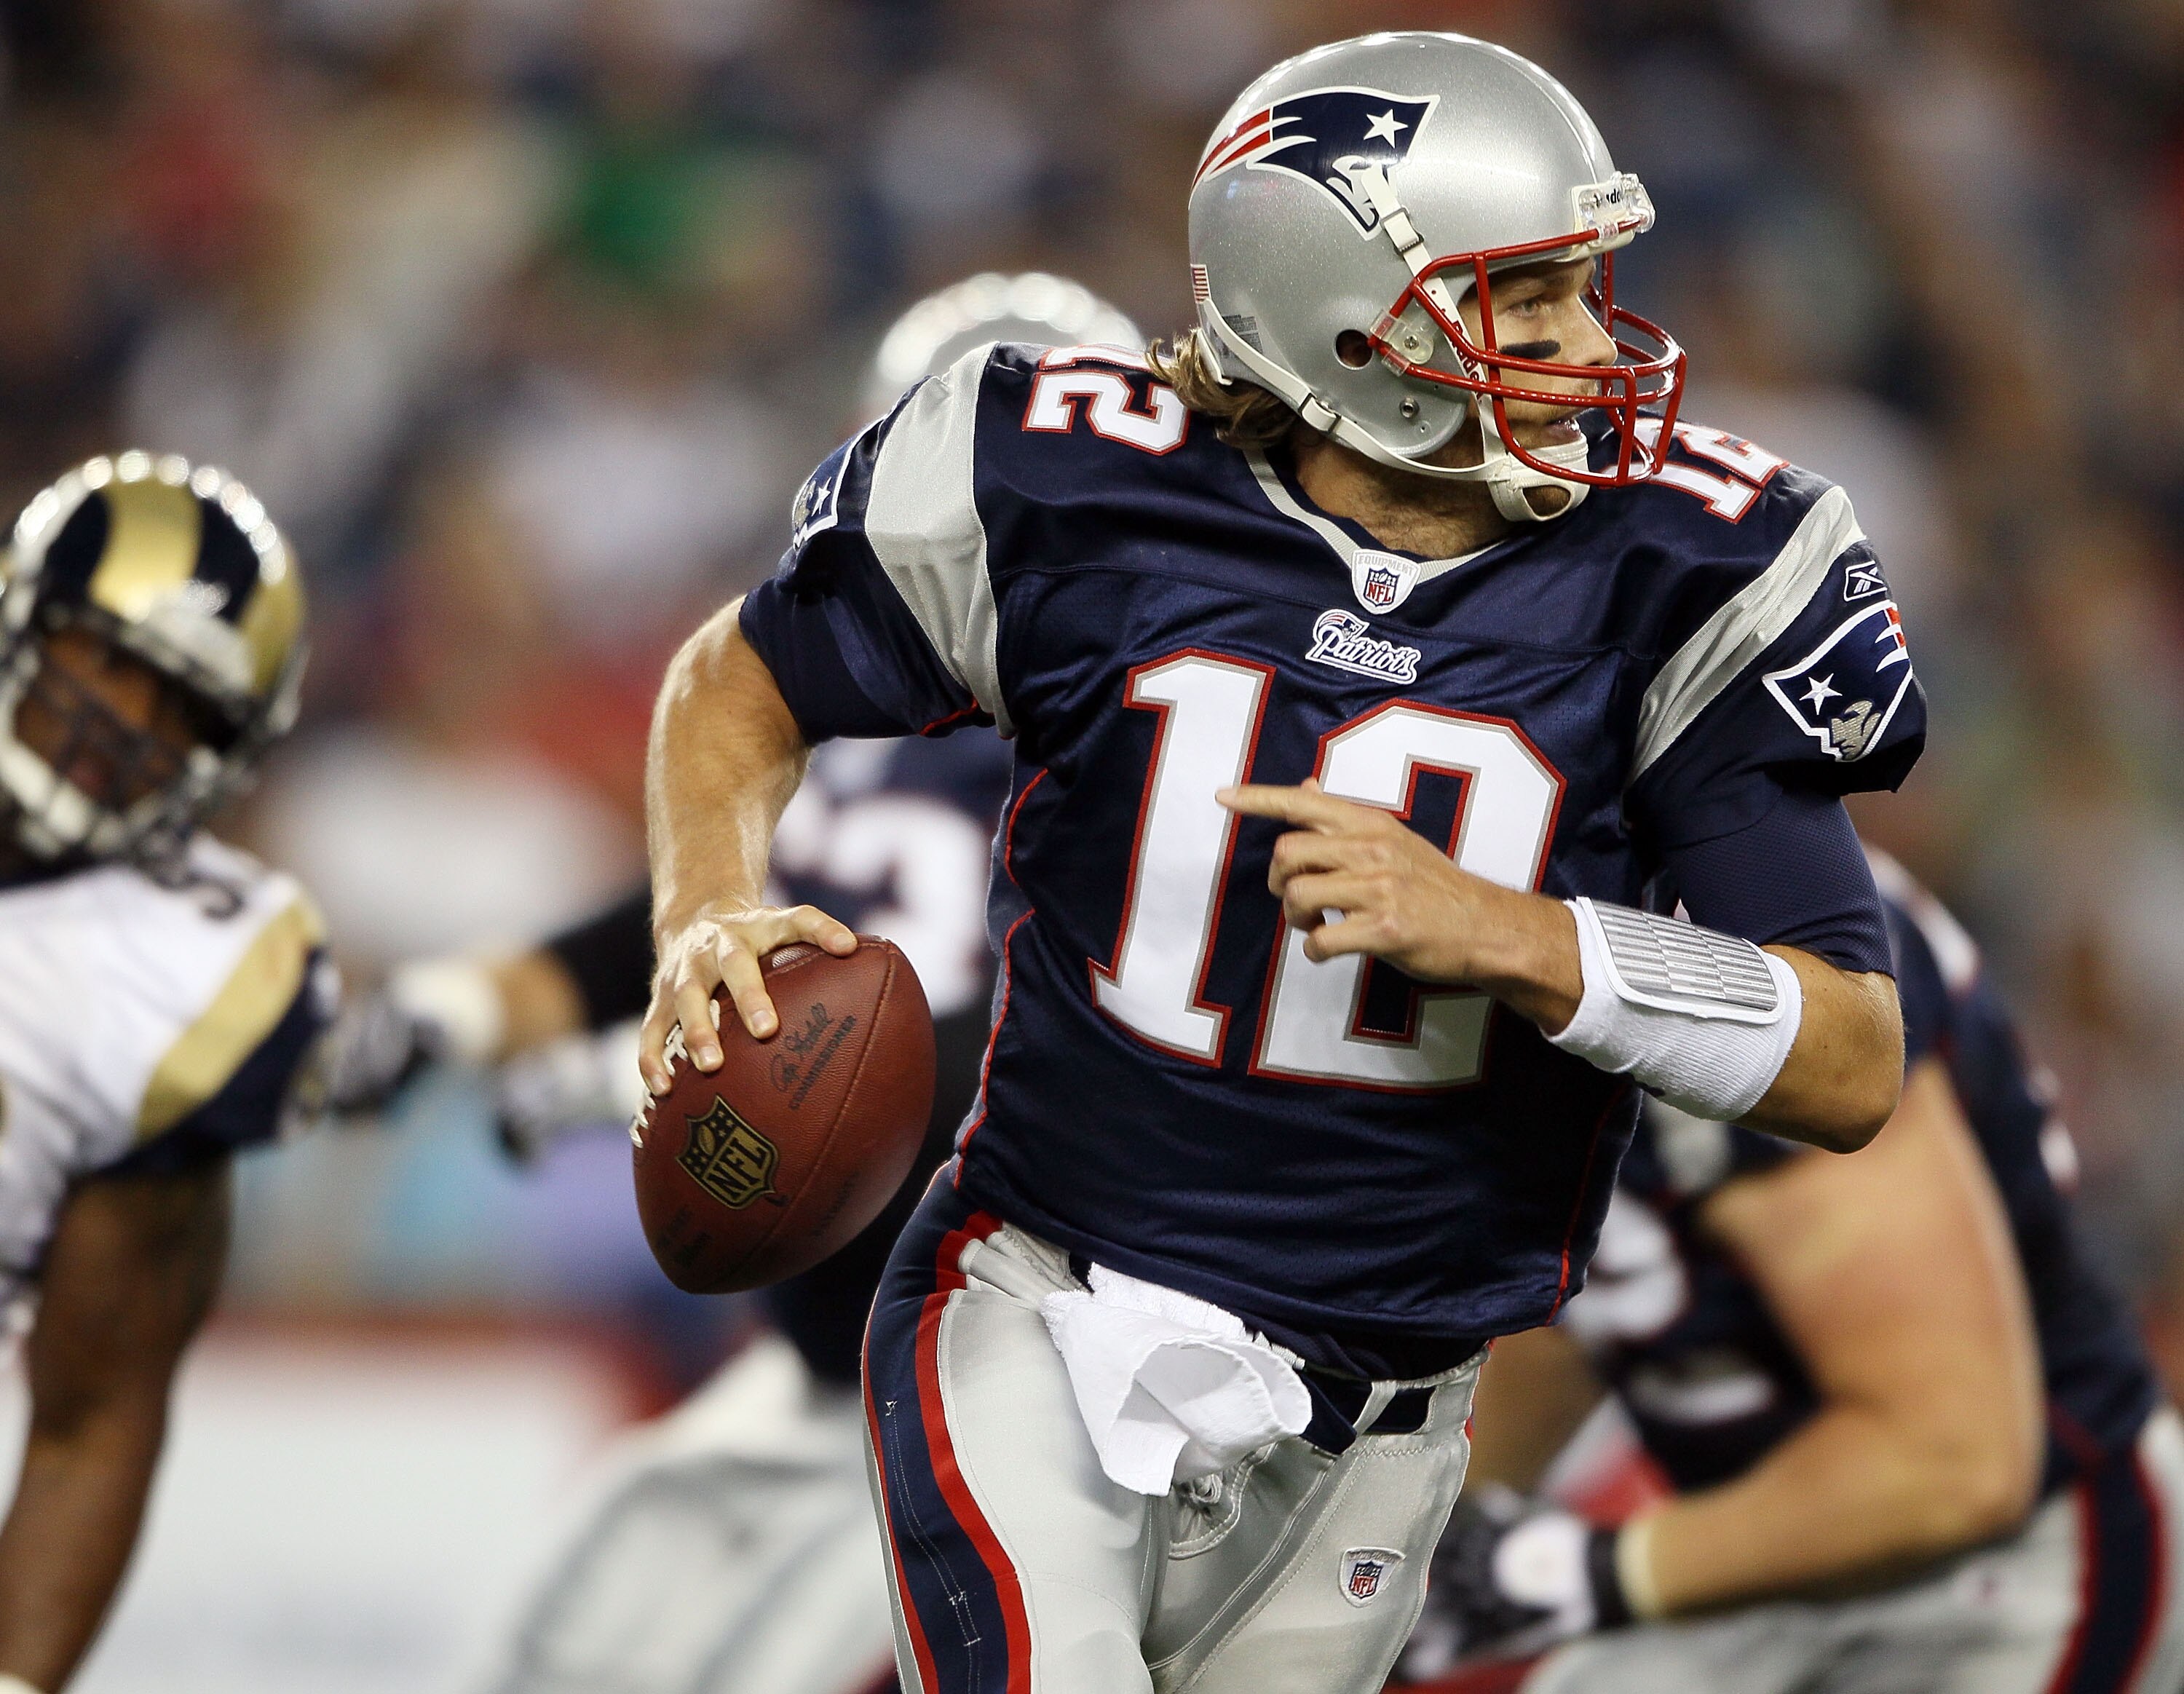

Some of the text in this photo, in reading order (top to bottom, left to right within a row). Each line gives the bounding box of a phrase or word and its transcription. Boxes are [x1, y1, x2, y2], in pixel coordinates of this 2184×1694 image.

[1021, 343, 1192, 456] 12
[1597, 418, 1789, 525] 12
[1357, 554, 1416, 577] EQUIPMENT
[1366, 583, 1393, 603] NFL
[1309, 624, 1419, 677] Patriots
[1088, 647, 1567, 1091] 12
[707, 1137, 767, 1199] NFL
[1350, 1576, 1375, 1595] NFL
